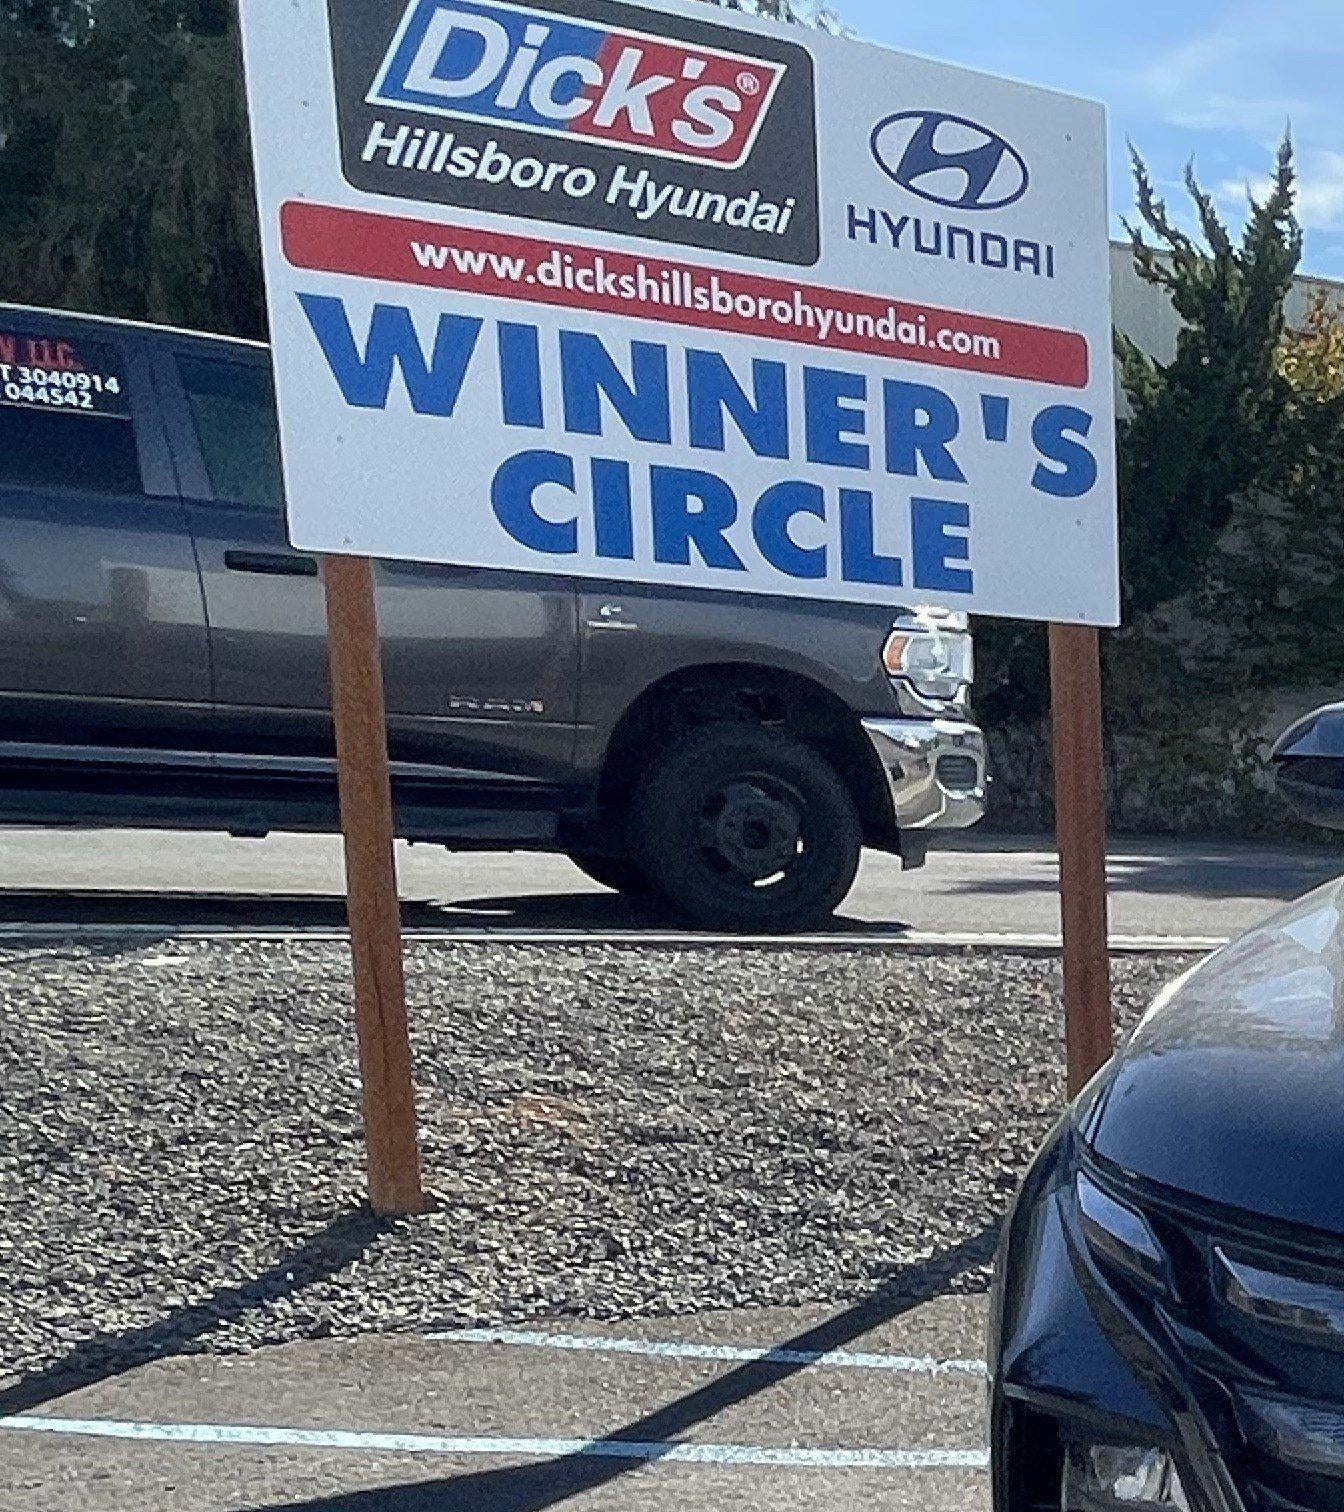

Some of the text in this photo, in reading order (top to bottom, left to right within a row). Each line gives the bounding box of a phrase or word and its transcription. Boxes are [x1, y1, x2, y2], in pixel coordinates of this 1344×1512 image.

[403, 8, 743, 149] Dick's
[361, 120, 796, 235] Hillsboro Hyundai
[409, 237, 1001, 361] www.dickshillsborohyundai.com
[846, 203, 1057, 279] HYUNDAI
[4, 382, 94, 410] 044542
[17, 365, 120, 394] 3040914
[295, 291, 1098, 499] WINNER'S
[491, 450, 976, 595] CIRCLE
